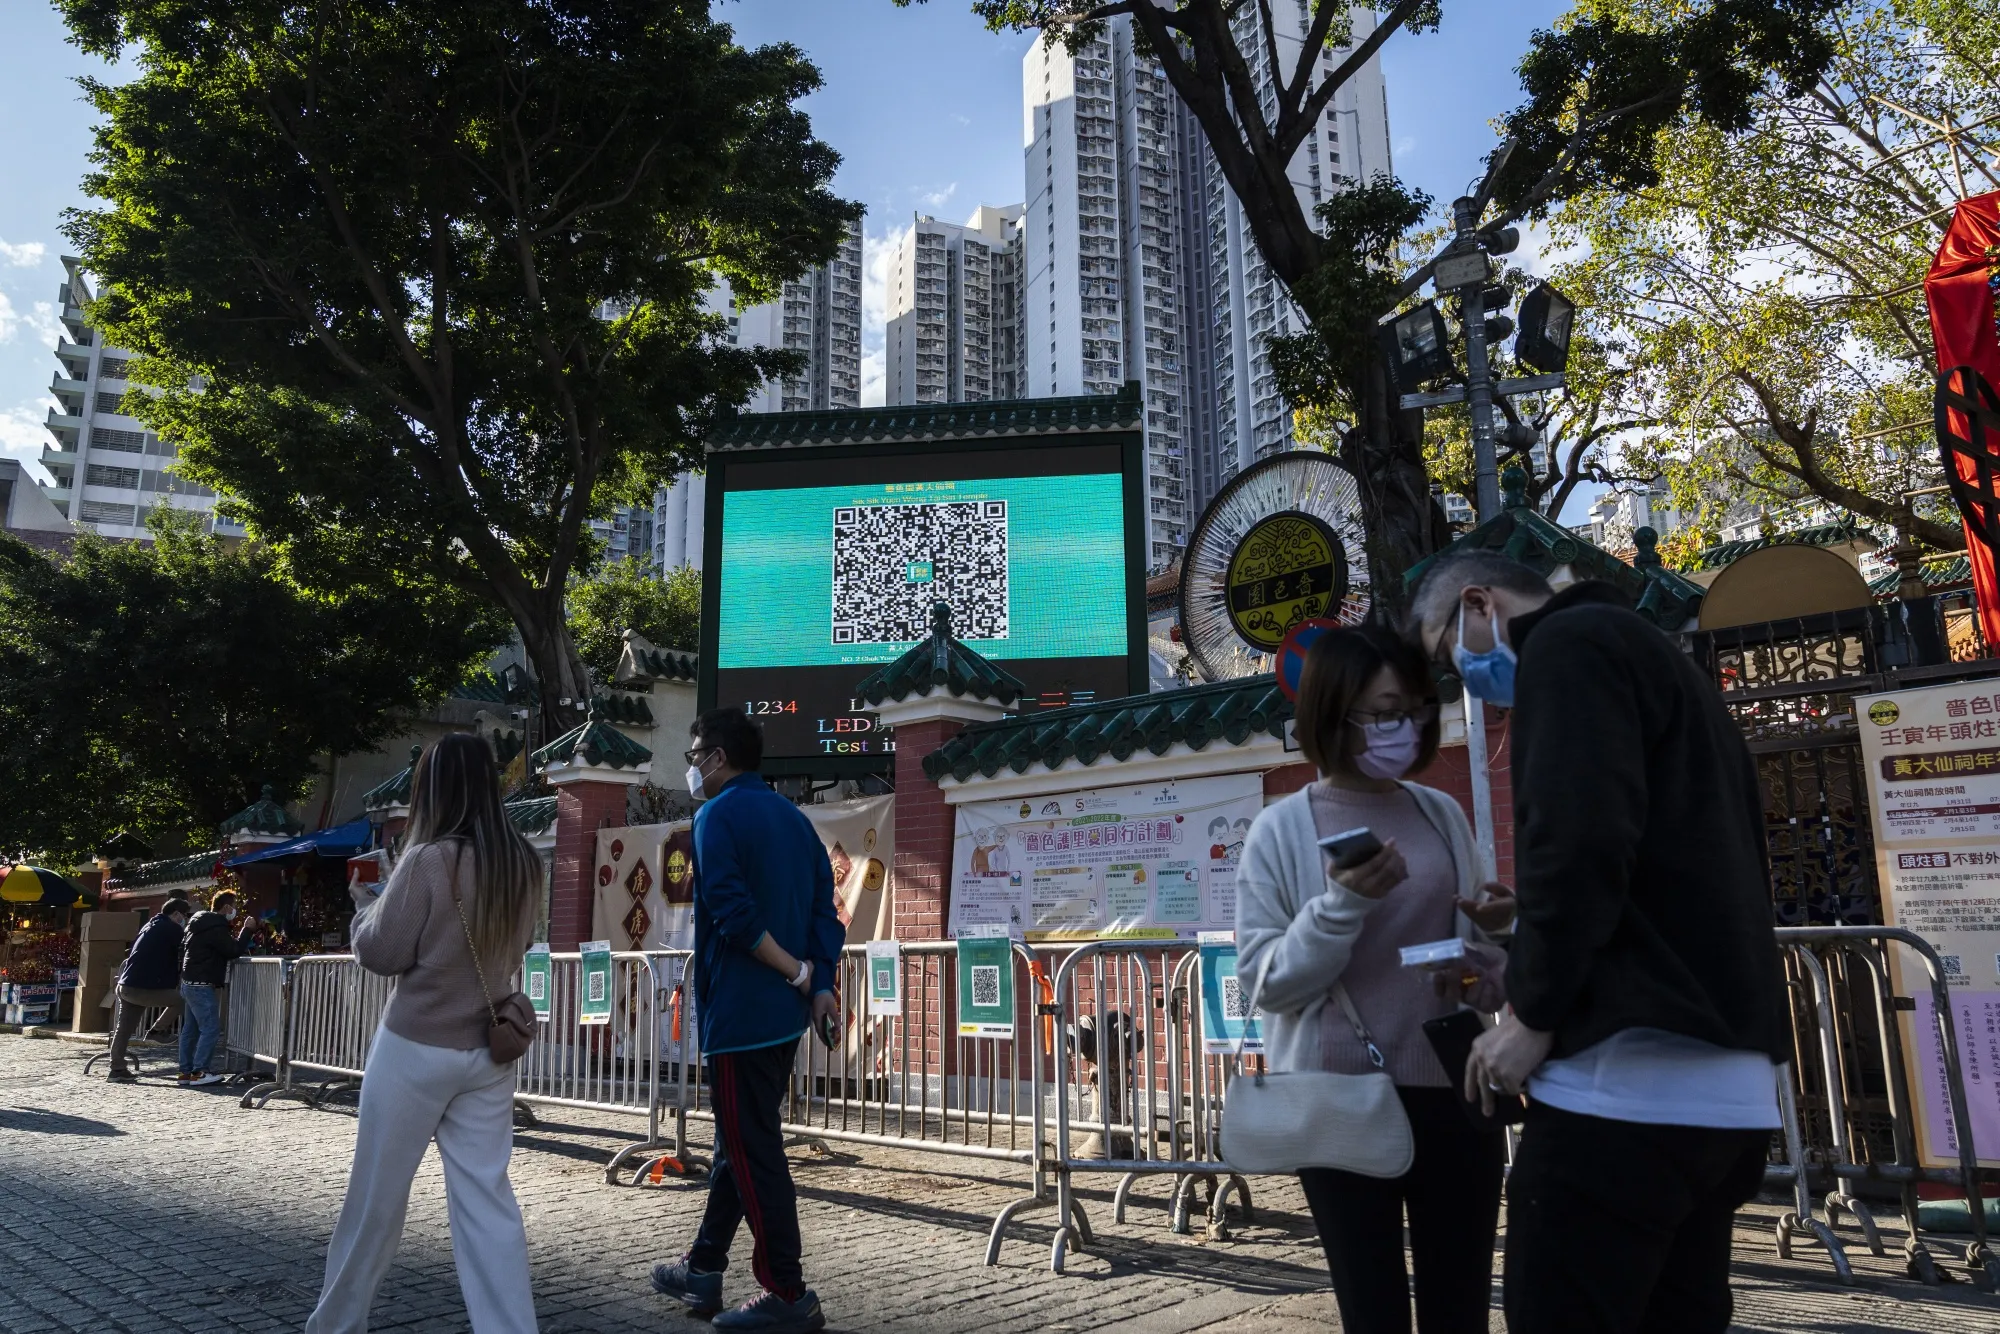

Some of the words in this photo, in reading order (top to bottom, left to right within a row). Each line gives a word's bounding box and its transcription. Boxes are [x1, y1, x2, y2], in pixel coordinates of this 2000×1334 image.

[745, 700, 798, 715] 1234
[1880, 718, 2000, 746] 壬寅年頭炷
[819, 739, 869, 753] Test
[1893, 752, 2000, 776] 黃大仙祠年
[1884, 785, 1966, 800] 黃大仙祠開放時間
[1901, 853, 1948, 868] 頭炷香
[632, 867, 648, 894] 虎
[629, 908, 646, 935] 虎
